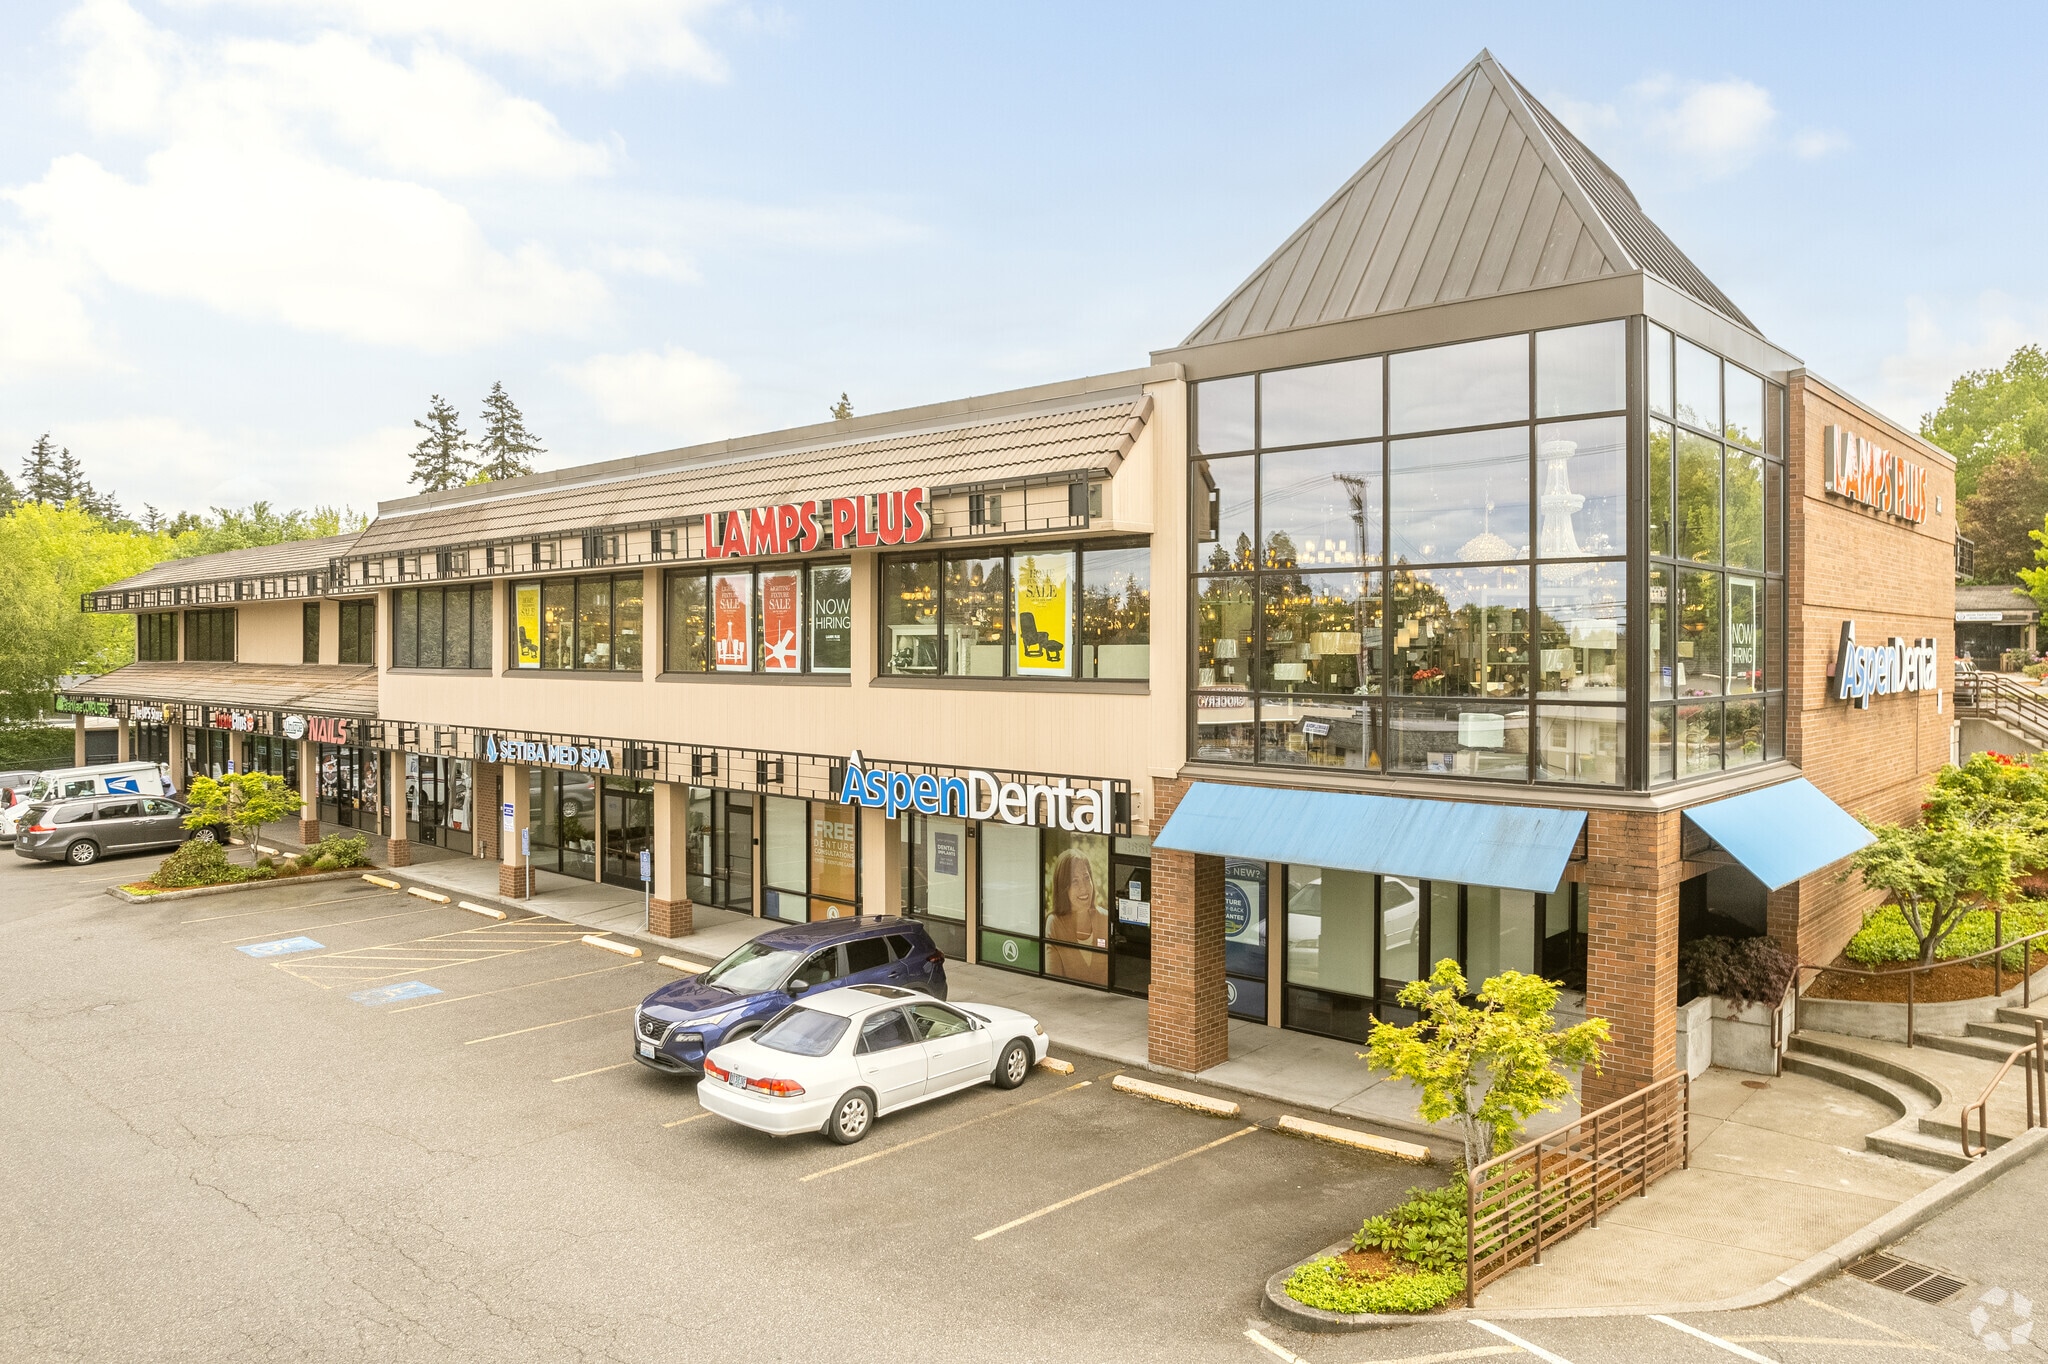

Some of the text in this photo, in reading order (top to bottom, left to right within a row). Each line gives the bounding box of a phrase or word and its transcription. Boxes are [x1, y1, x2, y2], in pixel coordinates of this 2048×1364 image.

[1832, 423, 1928, 526] LAMPS PLUS
[704, 487, 927, 559] LAMPS PLUS
[1026, 584, 1057, 598] SALE
[719, 598, 741, 610] SALE
[768, 598, 791, 610] SALE
[815, 598, 851, 615] NOW
[815, 616, 851, 630] HIRING
[1732, 622, 1754, 645] NOW
[1732, 647, 1753, 664] HIRING
[308, 716, 347, 745] NAILS
[500, 740, 610, 770] SETIBA MED SPA
[813, 819, 854, 842] FREE
[813, 838, 855, 852] DENTURE
[814, 847, 855, 860] CONSULTATIONS
[1233, 867, 1261, 878] NEW?
[1225, 898, 1242, 906] TURE
